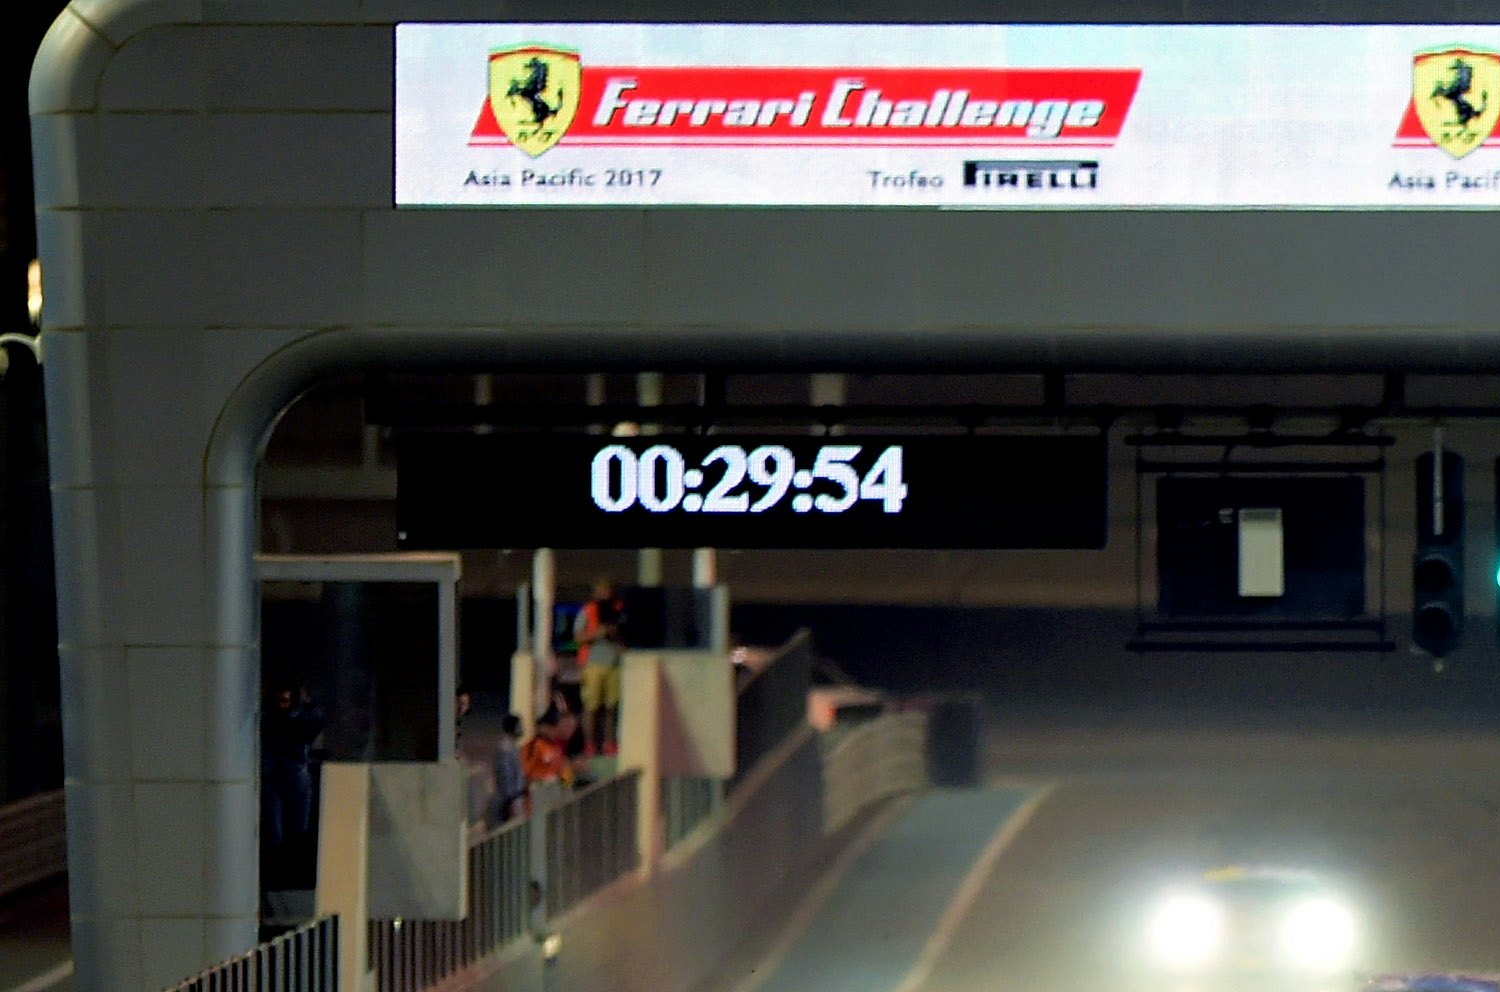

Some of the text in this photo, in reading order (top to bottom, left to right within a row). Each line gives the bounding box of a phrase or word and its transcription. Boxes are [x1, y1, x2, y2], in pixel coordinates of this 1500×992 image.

[592, 76, 1105, 139] Ferrari Challenge
[463, 167, 664, 189] Asia Pacific 2017
[869, 159, 1100, 190] Trofeo PIRELLI
[1387, 172, 1436, 191] Asia
[591, 444, 908, 513] 00:29:54
